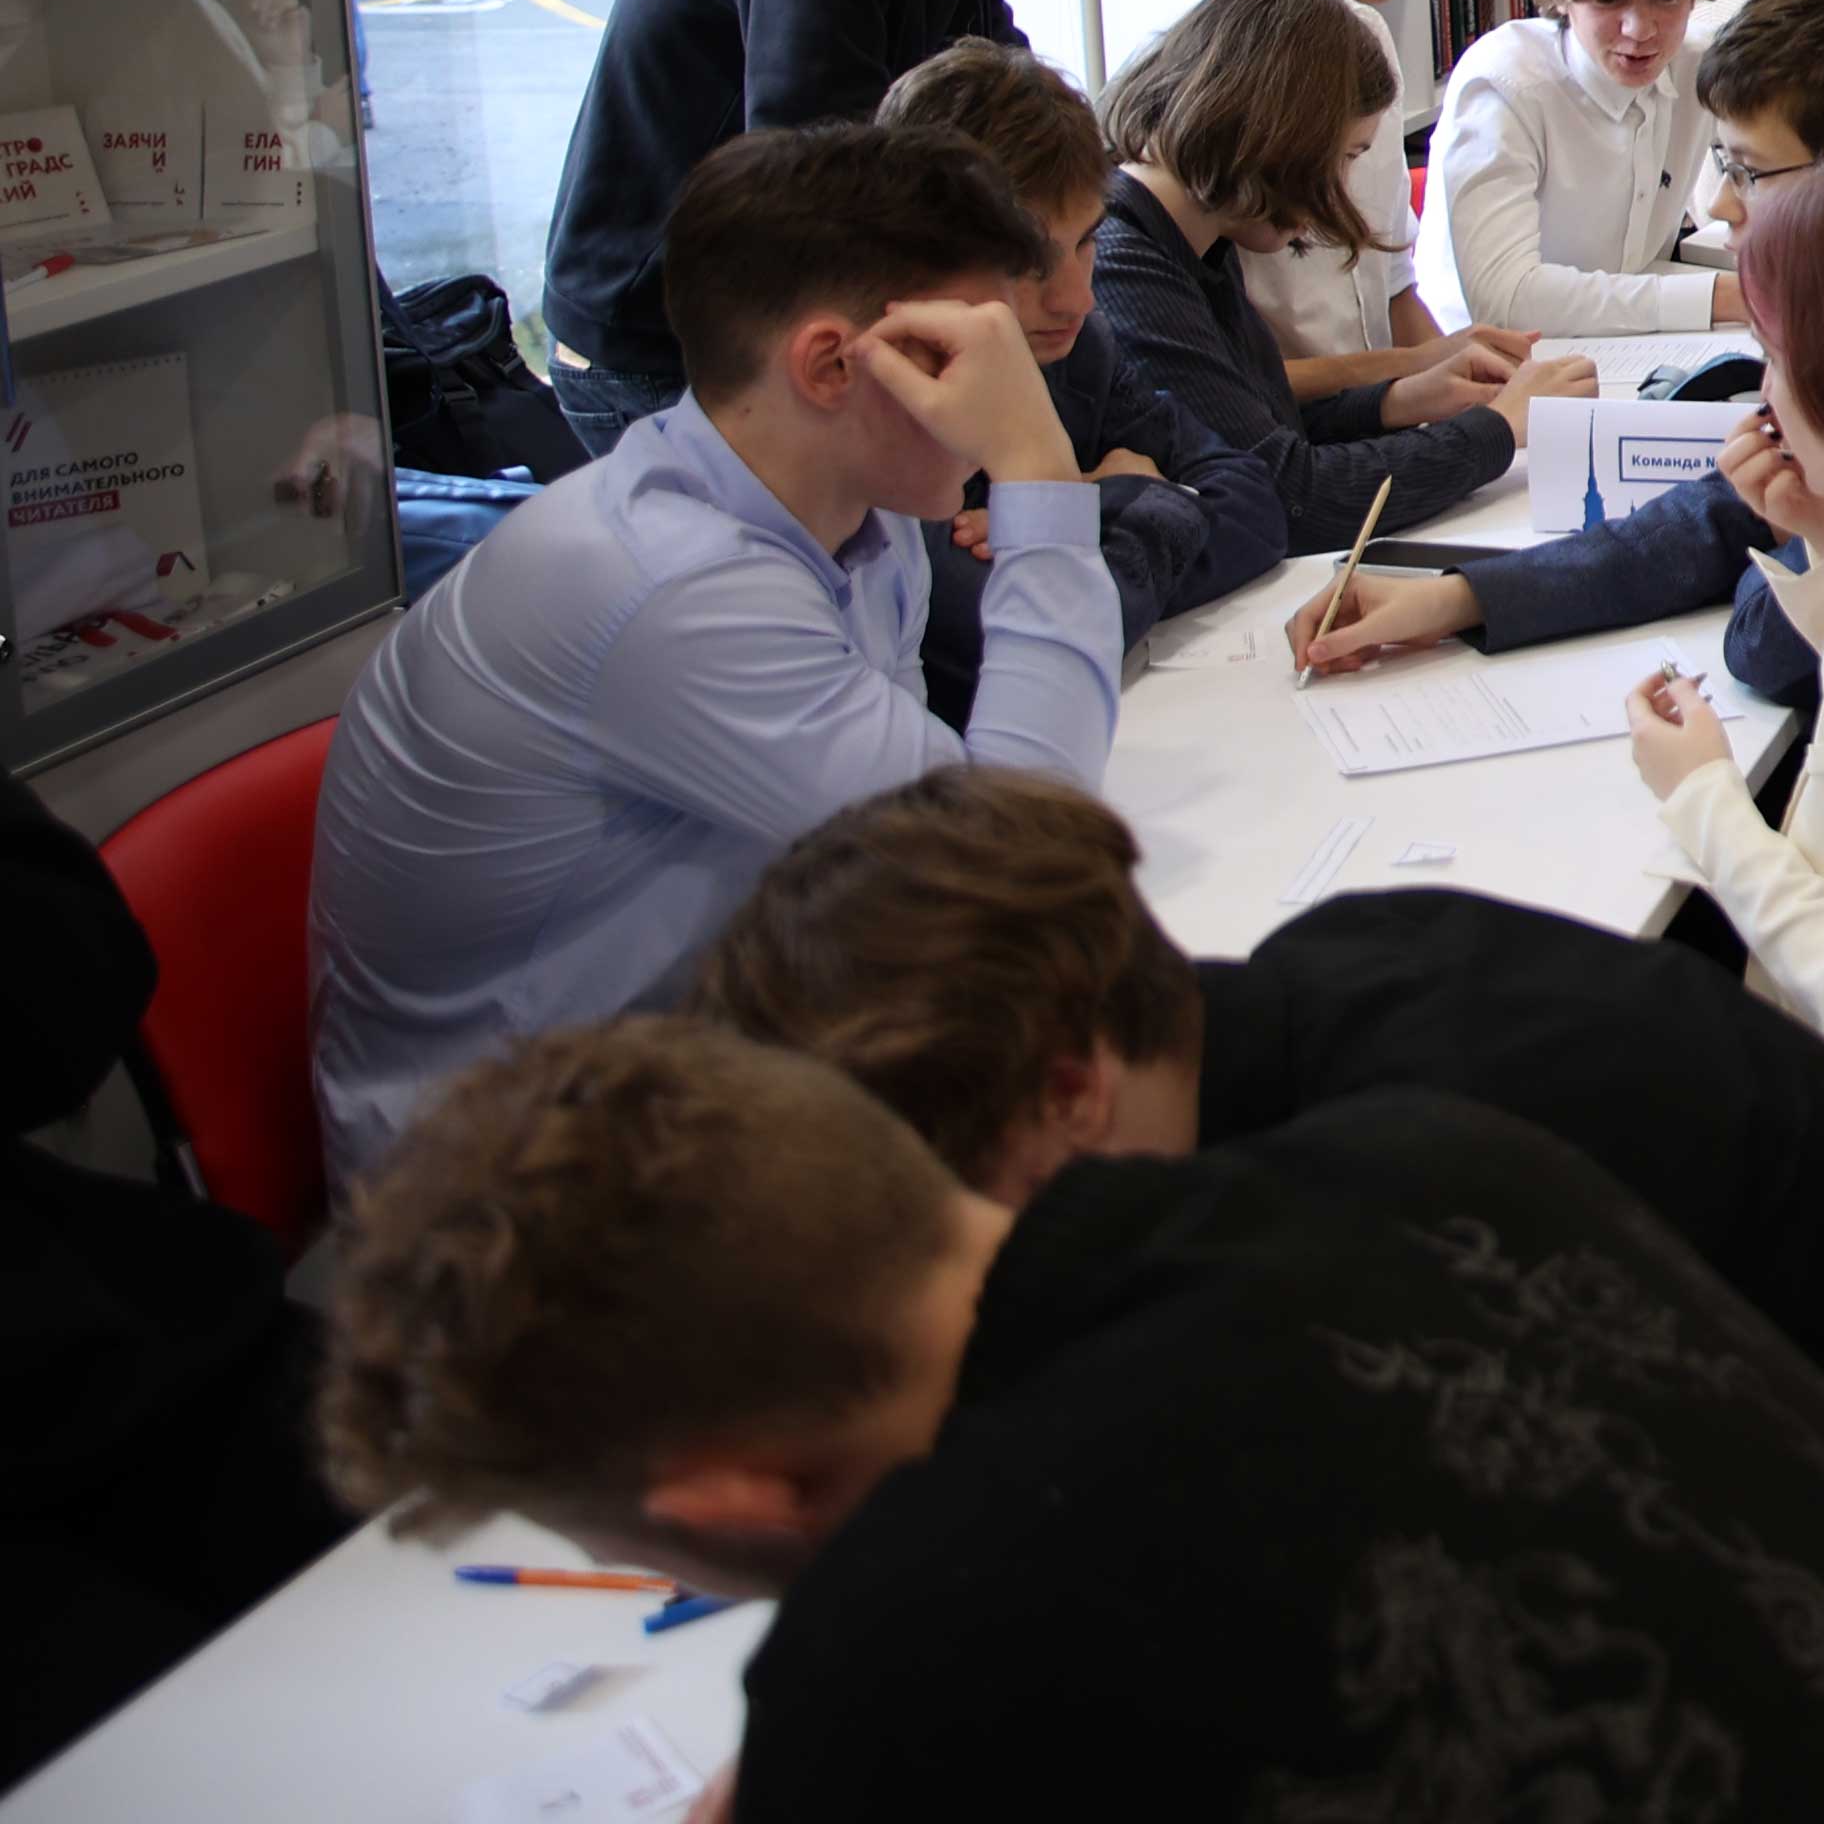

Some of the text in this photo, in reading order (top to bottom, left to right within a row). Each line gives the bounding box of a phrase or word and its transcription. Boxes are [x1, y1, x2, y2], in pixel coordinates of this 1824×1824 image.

[102, 131, 167, 150] ЗАЯЧИ
[243, 132, 283, 150] ЕЛА
[6, 153, 75, 178] ГРАДС
[242, 154, 282, 172] ГИН
[10, 451, 140, 488] ДЛЯ САМОГО
[1632, 454, 1701, 470] Команда
[11, 462, 186, 506] ВНИМАТЕЛЬНОГО
[12, 494, 116, 524] ЧИТАТЕЛЯ
